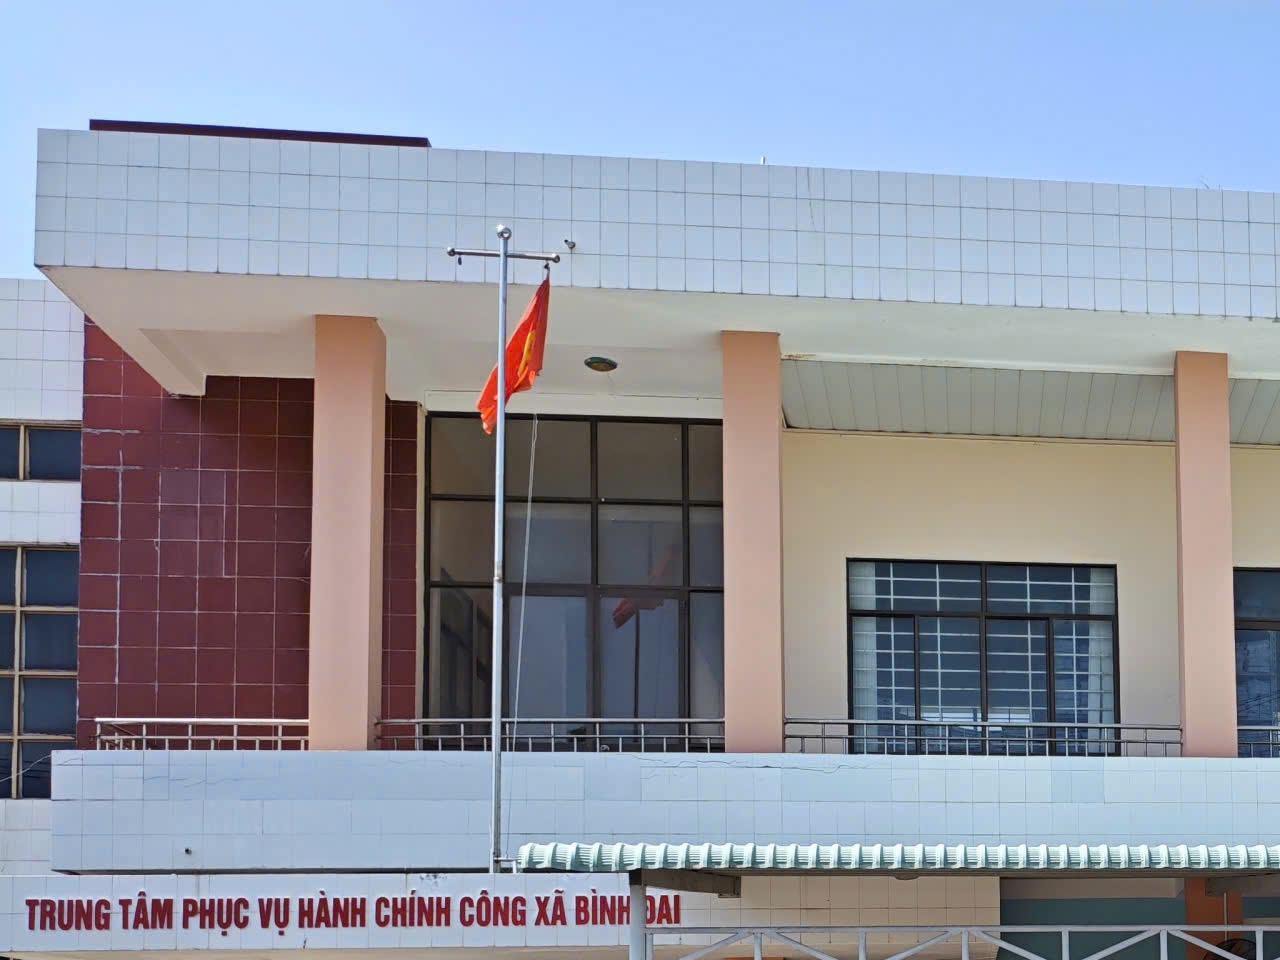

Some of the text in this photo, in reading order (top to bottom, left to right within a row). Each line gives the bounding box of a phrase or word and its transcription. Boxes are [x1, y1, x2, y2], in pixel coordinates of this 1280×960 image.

[25, 898, 111, 931] TRUNG
[118, 890, 174, 930] TÂM
[182, 897, 250, 936] PHỤC
[258, 898, 290, 936] VỤ
[298, 890, 366, 929] HÀNH
[375, 889, 450, 928] CHÍNH
[459, 889, 527, 927] CÔNG
[534, 889, 567, 926] XÃ
[575, 888, 631, 925] BÌNH
